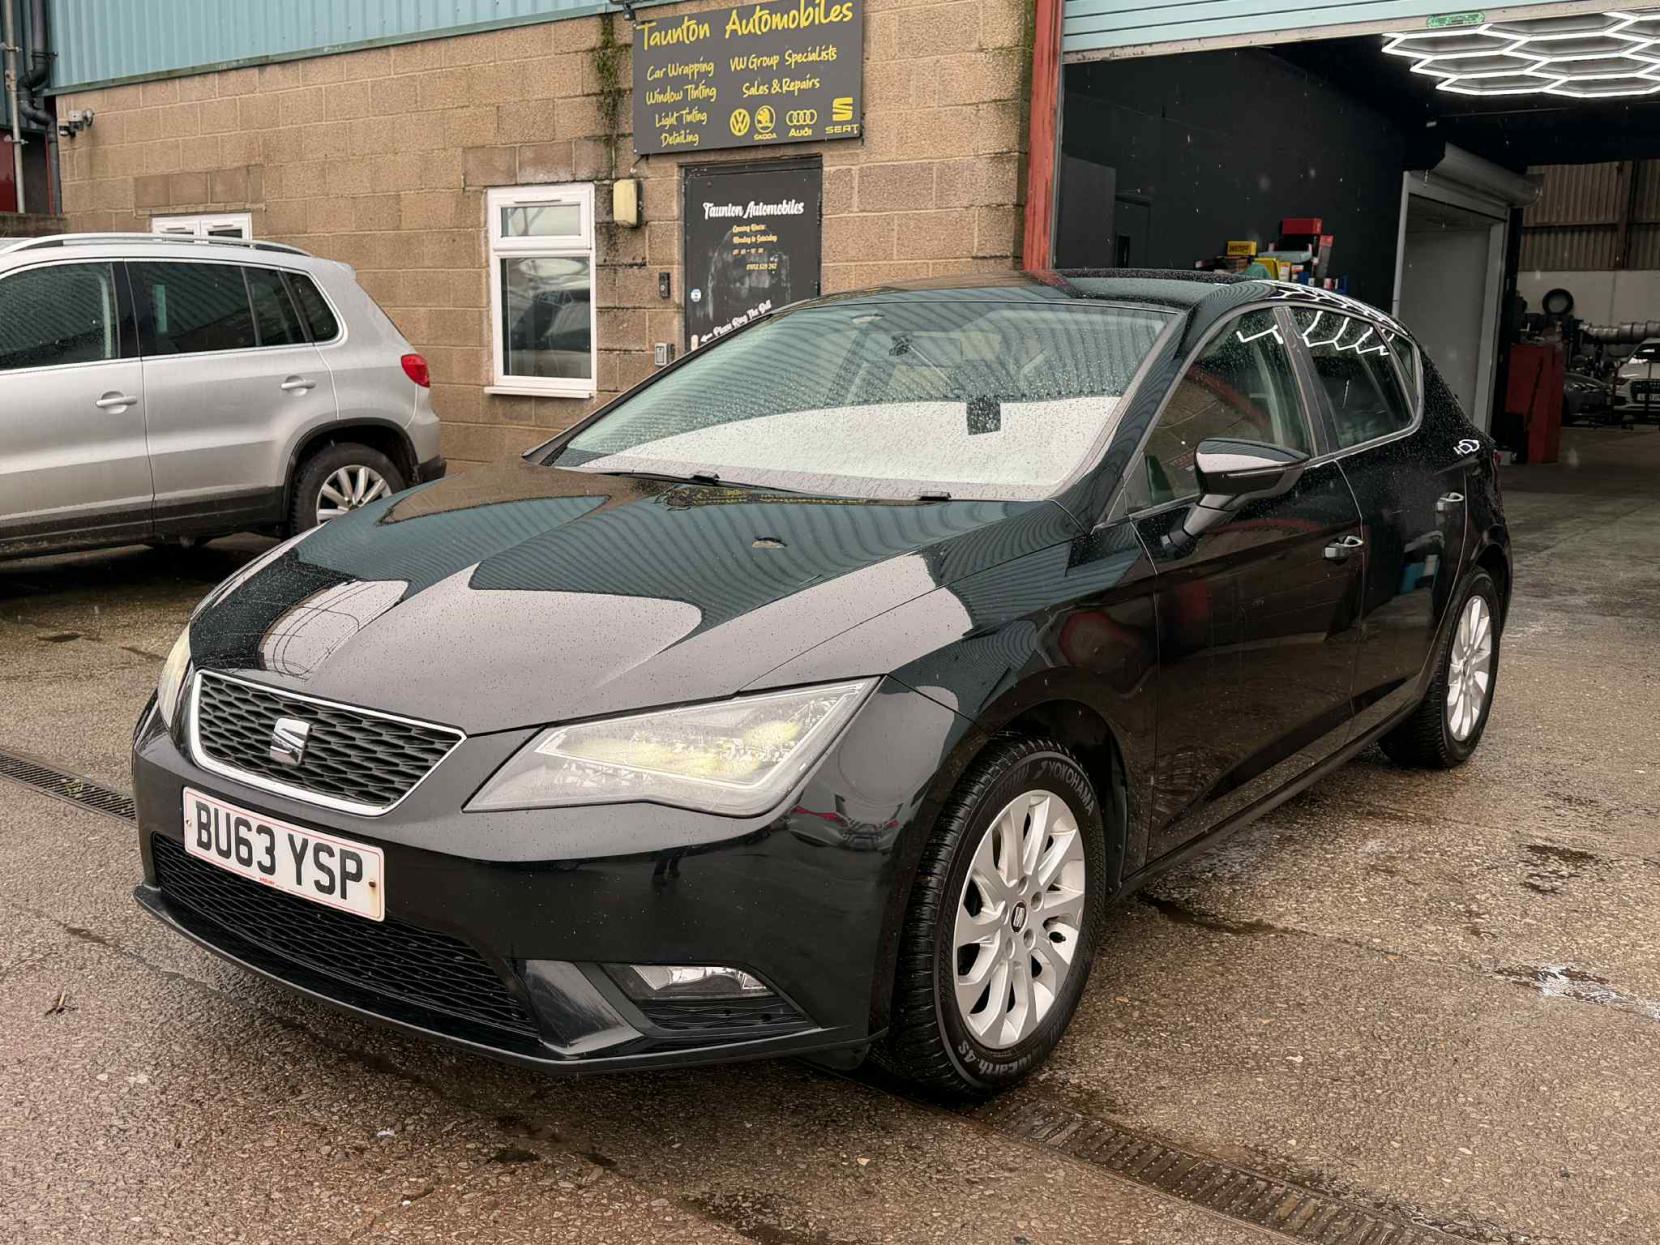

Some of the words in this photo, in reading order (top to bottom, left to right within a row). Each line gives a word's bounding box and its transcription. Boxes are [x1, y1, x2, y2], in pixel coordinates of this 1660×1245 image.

[637, 16, 710, 50] Taunton
[725, 0, 853, 39] Automobiles
[647, 65, 666, 81] Car
[667, 56, 715, 80] Wrapping
[730, 56, 747, 72] VW
[748, 54, 779, 71] Group
[785, 44, 838, 69] Specialists
[646, 85, 683, 105] Window
[684, 80, 717, 102] Tinting
[743, 80, 769, 98] Sales
[771, 79, 782, 94] &
[782, 74, 820, 96] Repairs
[655, 111, 680, 130] Light
[680, 106, 708, 125] Tinting
[825, 124, 859, 135] SEAT
[661, 130, 699, 147] Detailing
[788, 127, 813, 138] Audi
[703, 202, 744, 220] Taunton
[743, 199, 804, 219] Automobiles
[1048, 760, 1095, 817] YOKOHAMA
[195, 800, 277, 877] BU63
[288, 833, 363, 900] YSP
